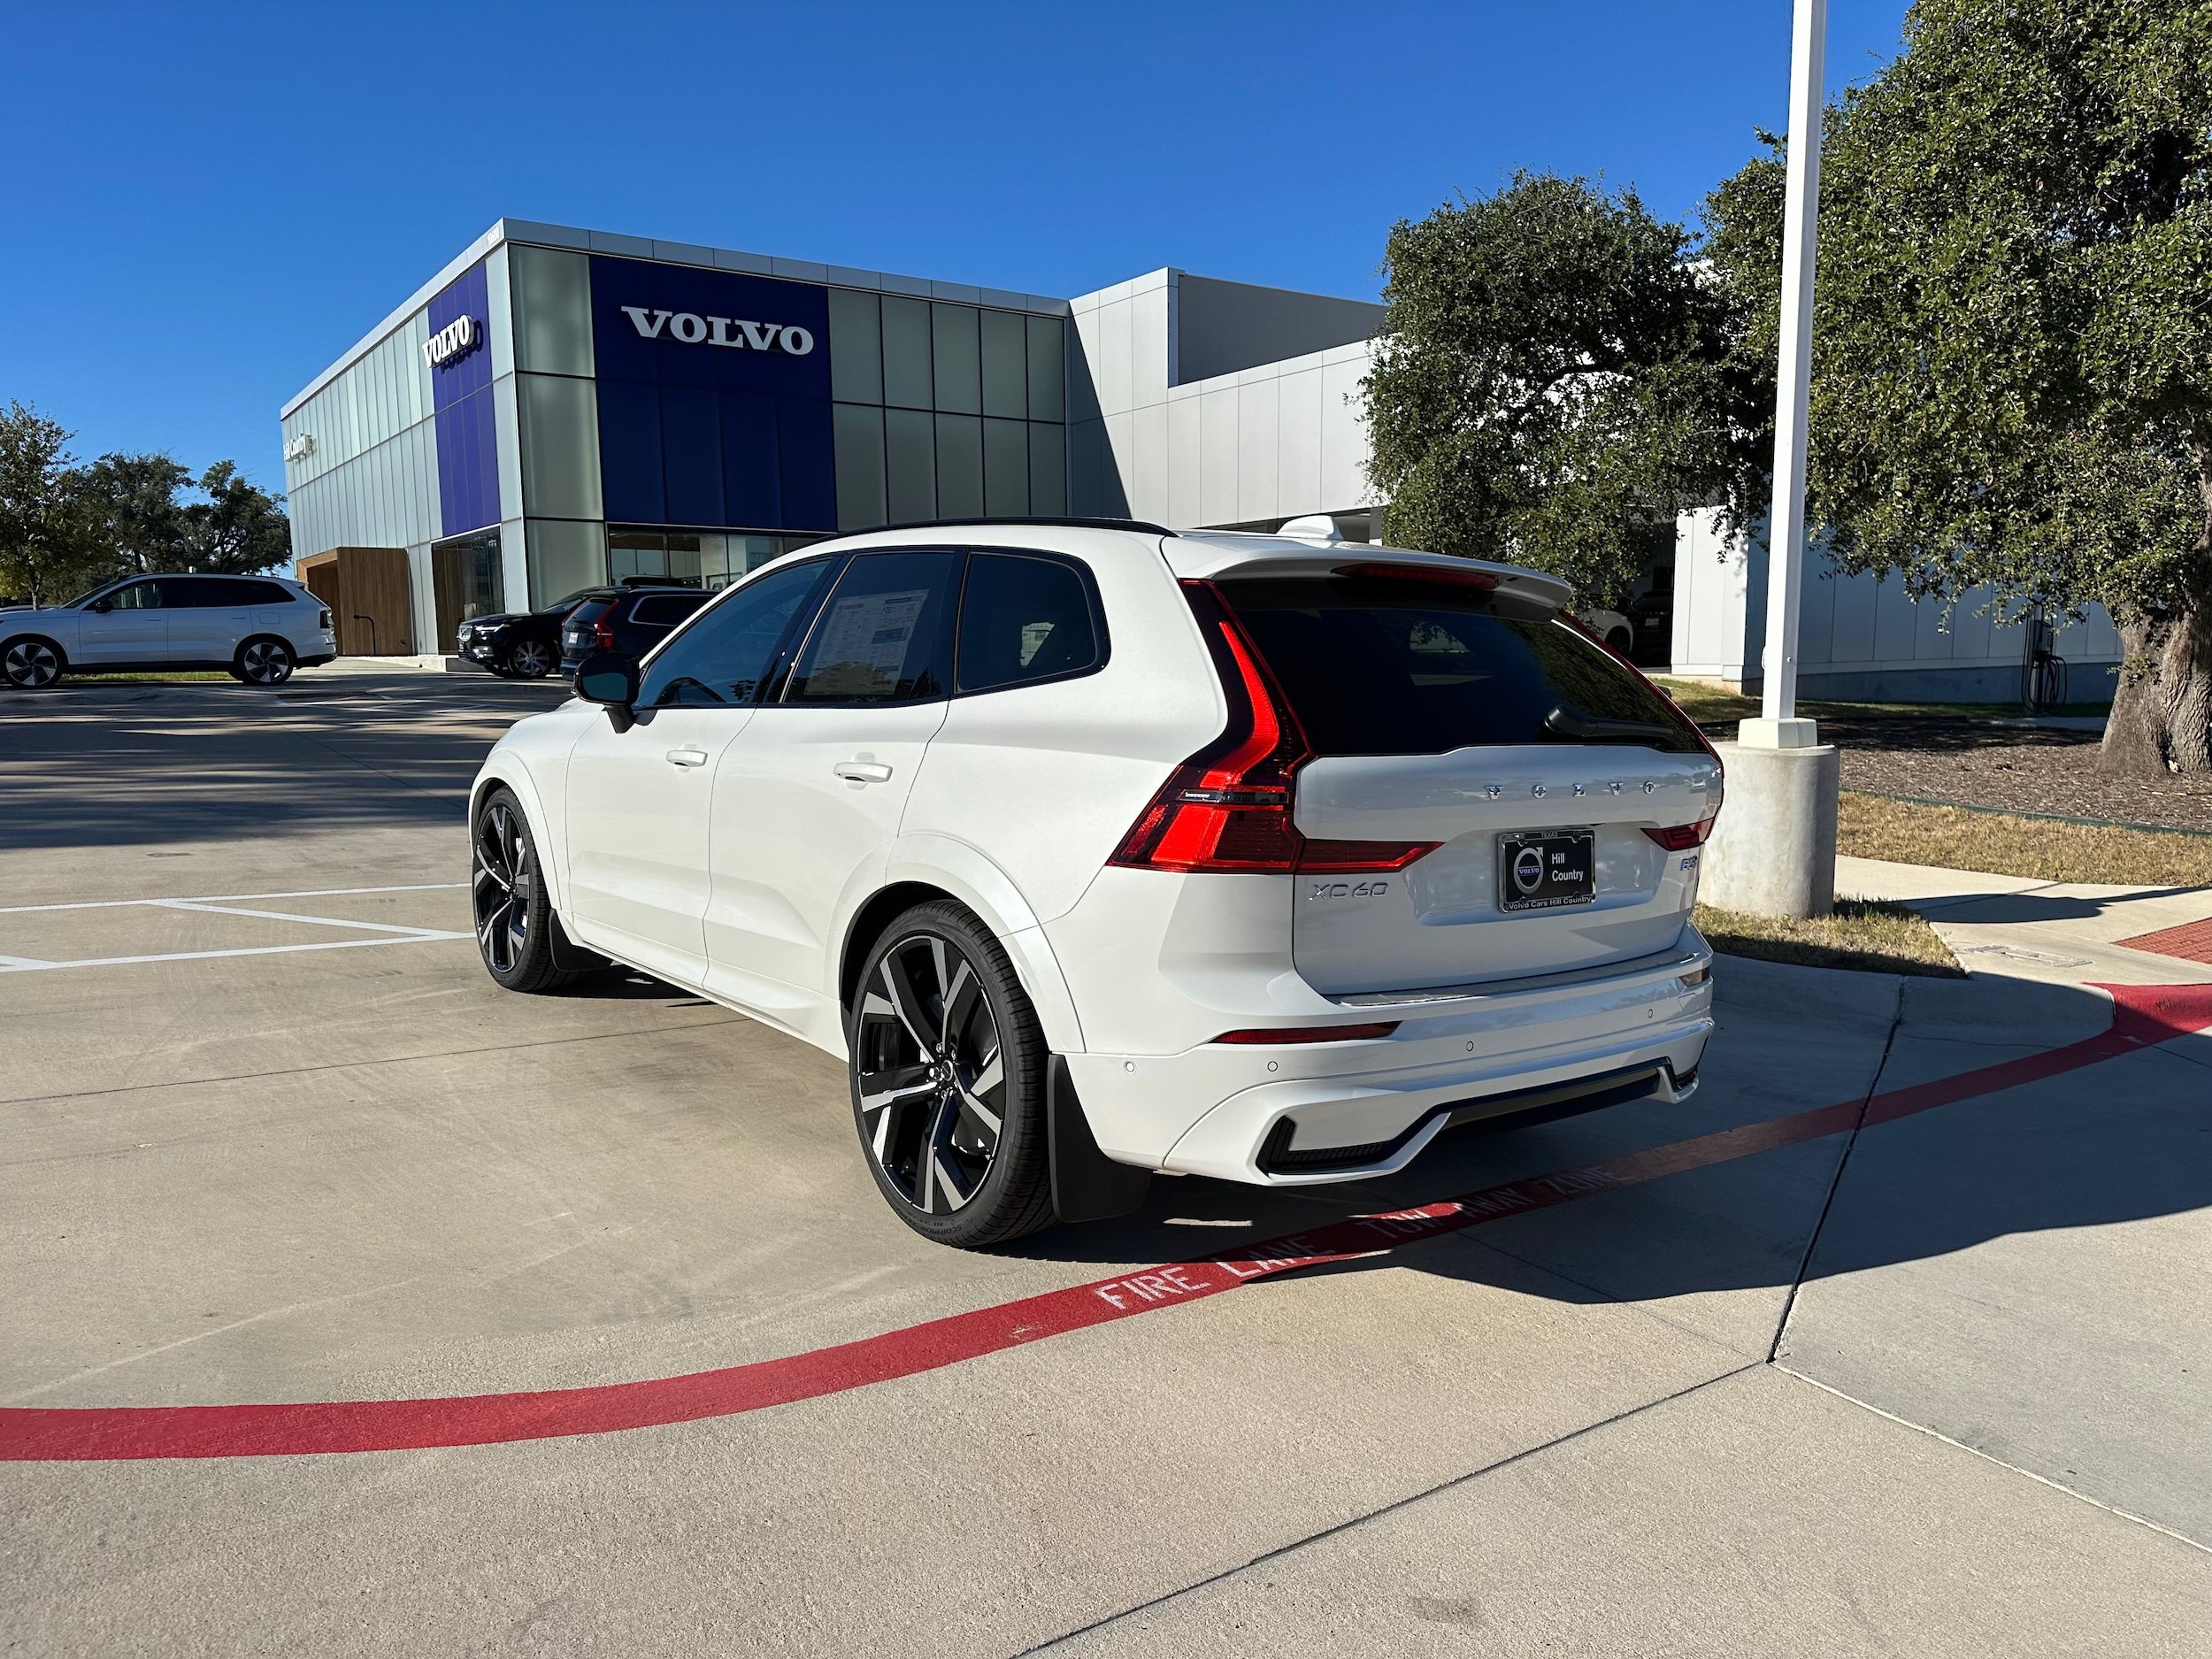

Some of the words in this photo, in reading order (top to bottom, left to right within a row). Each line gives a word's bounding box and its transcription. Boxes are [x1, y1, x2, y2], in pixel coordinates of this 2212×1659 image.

[621, 305, 814, 356] VOLVO
[421, 314, 472, 369] VOLVO
[1484, 780, 1656, 800] VOLVO
[1540, 831, 1558, 840] TEXAS
[1551, 852, 1565, 864] Hill
[1551, 869, 1584, 882] Country
[1509, 902, 1530, 910] Volvo
[1563, 895, 1592, 904] Country
[1093, 1266, 1211, 1310] FIRE
[1210, 1236, 1336, 1278] LANE
[1353, 1208, 1445, 1239] TOW
[1449, 1187, 1537, 1218] AWAY
[1531, 1166, 1635, 1195] ZONE
